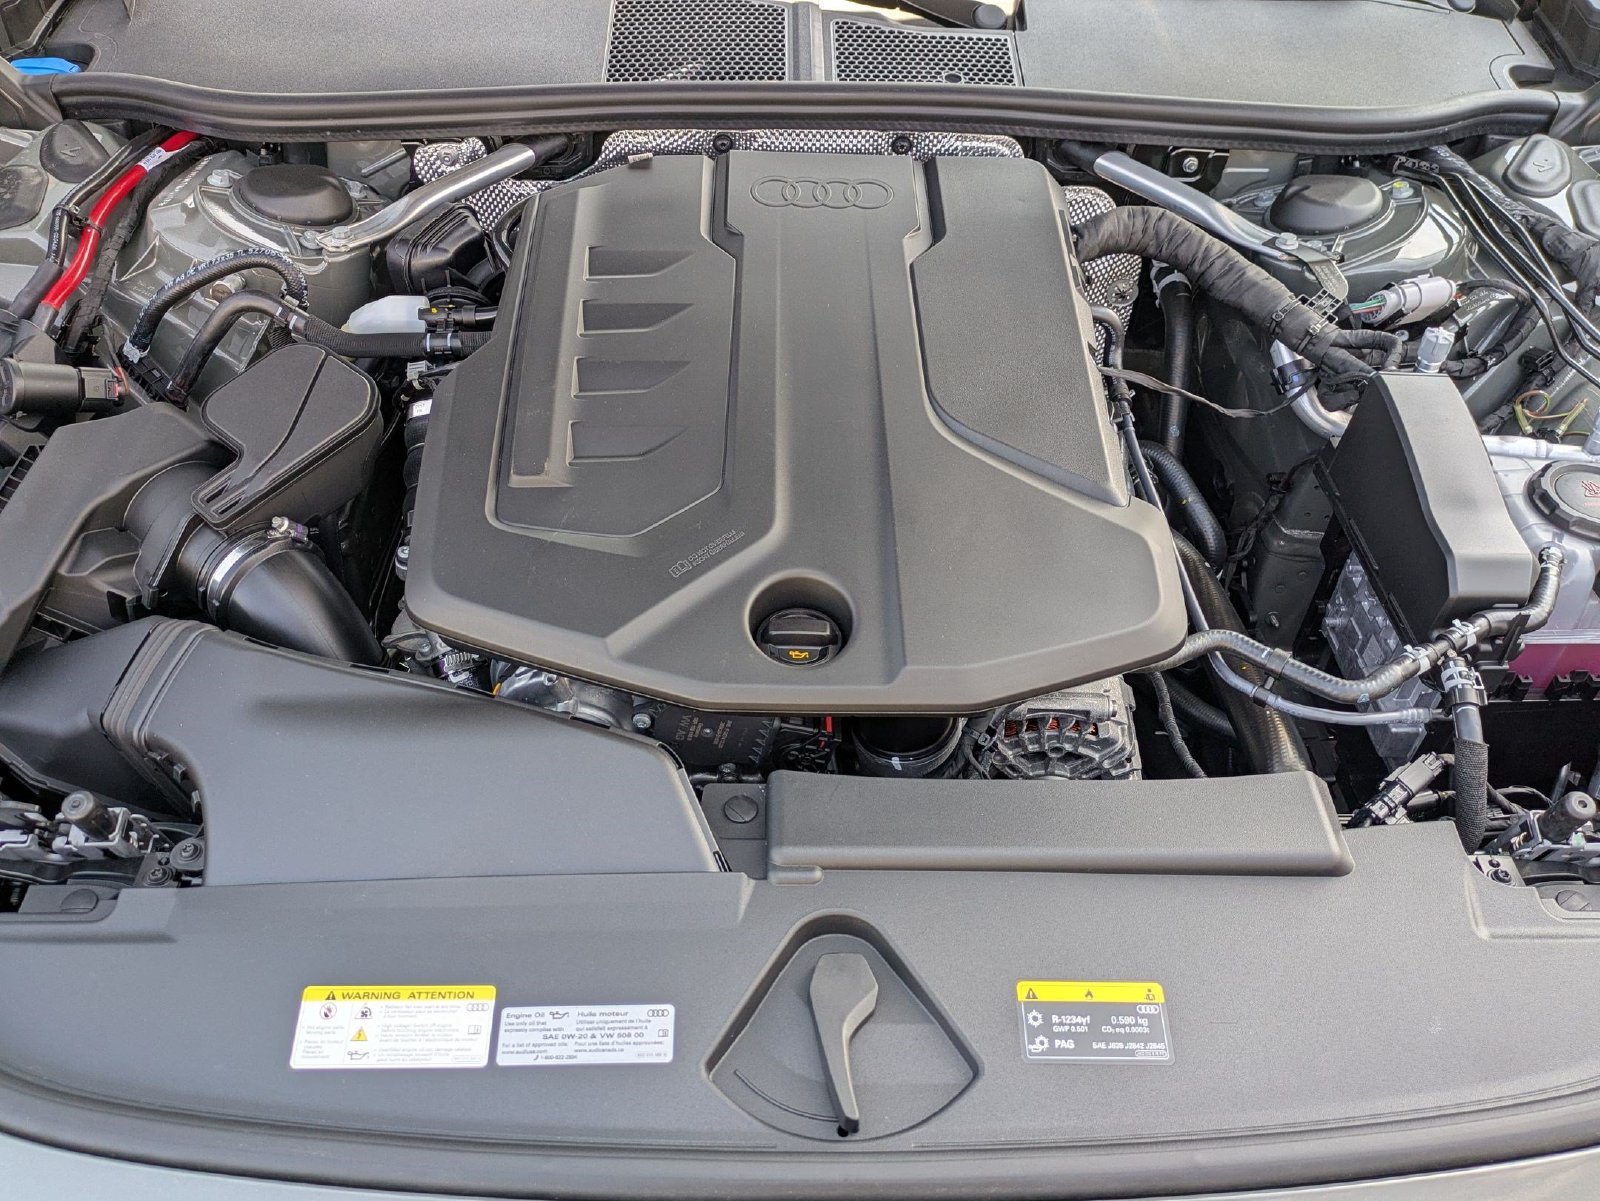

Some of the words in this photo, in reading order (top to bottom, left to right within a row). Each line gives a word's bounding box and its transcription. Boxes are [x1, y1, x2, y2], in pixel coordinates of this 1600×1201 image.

[697, 545, 709, 556] NOT
[675, 727, 685, 741] AG
[341, 991, 401, 1000] WARNING
[407, 991, 475, 1000] ATTENTION
[506, 1012, 532, 1020] Engine
[1051, 1014, 1091, 1026] R-1234yf
[1110, 1015, 1136, 1025] 0.590
[1137, 1015, 1149, 1027] kg
[1052, 1025, 1069, 1033] GWP
[1070, 1025, 1089, 1033] 0.501
[1054, 1039, 1075, 1049] PAG
[1092, 1041, 1106, 1049] SAE
